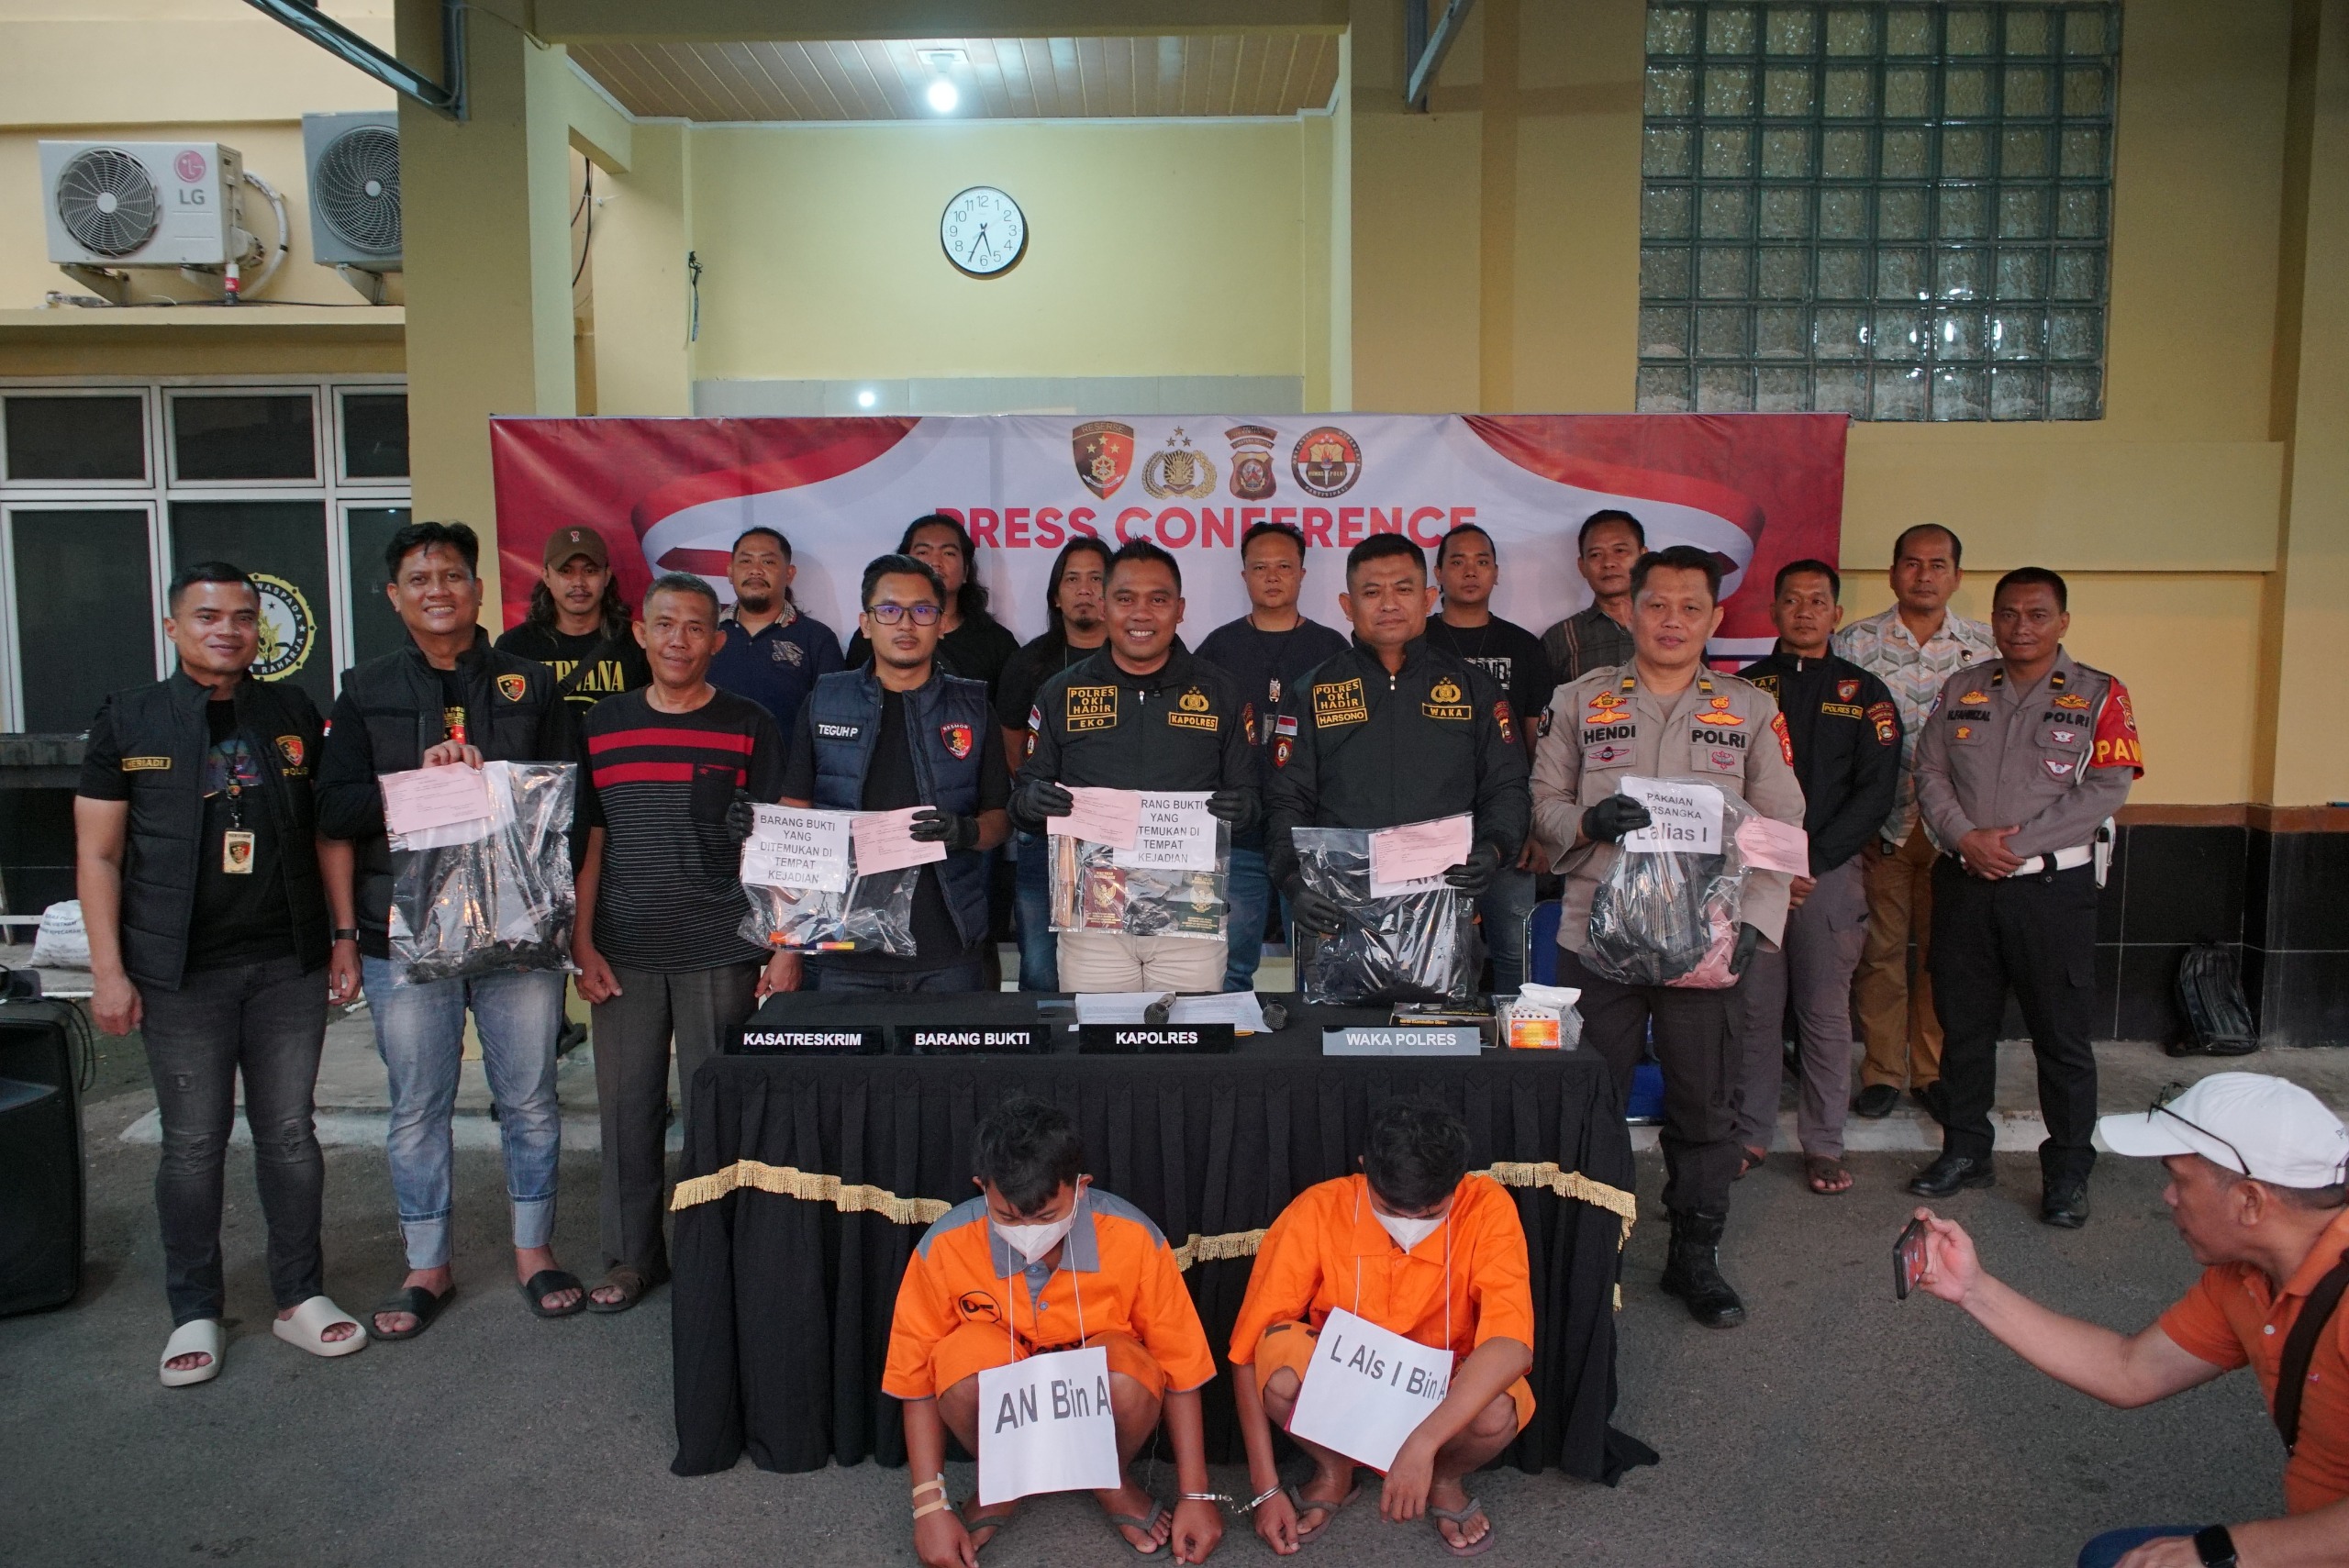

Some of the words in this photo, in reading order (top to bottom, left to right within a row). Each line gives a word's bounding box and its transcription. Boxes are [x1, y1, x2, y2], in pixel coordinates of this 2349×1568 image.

[179, 189, 205, 205] LG
[976, 195, 989, 207] 12
[964, 199, 974, 211] 11
[954, 210, 967, 222] 10
[1003, 210, 1012, 221] 2
[950, 226, 958, 237] 9
[1008, 225, 1017, 236] 3
[954, 240, 963, 251] 8
[1004, 239, 1013, 250] 4
[968, 251, 974, 262] 7
[980, 255, 988, 266] 6
[993, 250, 1001, 262] 5
[1082, 422, 1125, 434] RESERSE
[936, 506, 1097, 549] RESS
[261, 638, 305, 674] RAHARJA
[1071, 689, 1115, 698] POLRES
[1316, 682, 1360, 695] POLRES
[1082, 697, 1104, 706] OKI
[1328, 693, 1350, 701] OKI
[1074, 705, 1111, 714] HADIR
[1320, 698, 1359, 709] HADIR
[1430, 707, 1462, 717] WAKA
[1825, 706, 1850, 714] POLRES
[1080, 719, 1105, 728] EKO
[1171, 716, 1215, 728] KAPOLRES
[1319, 712, 1364, 725] HARSONO
[2043, 712, 2089, 728] POLRI
[818, 724, 850, 737] TEGUH
[850, 728, 858, 737] P
[1584, 725, 1636, 744] HENDI
[1692, 730, 1745, 749] POLRI
[1141, 799, 1170, 809] RANG
[1174, 800, 1203, 809] BUKTI
[1646, 793, 1693, 806] PAKAIAN
[1151, 813, 1179, 823] YANG
[1643, 806, 1702, 819] RSANGKA
[760, 815, 803, 828] BARANG
[807, 819, 836, 831] BUKTI
[784, 829, 812, 841] YANG
[1138, 826, 1186, 836] TEMUKAN
[1190, 828, 1199, 836] DI
[1650, 822, 1695, 841] alias
[760, 841, 820, 856] DITEMUKAN
[822, 848, 832, 857] DI
[1143, 840, 1184, 850] TEMPAT
[775, 857, 816, 869] TEMPAT
[1138, 852, 1187, 863] KEJADIAN
[768, 870, 819, 884] KEJADIAN
[743, 1033, 862, 1046] KASATRESKRIM
[916, 1033, 981, 1046] BARANG
[985, 1032, 1030, 1045] BUKTI
[1116, 1031, 1198, 1045] KAPOLRES
[1346, 1033, 1393, 1046] WAKA
[1396, 1033, 1457, 1046] POLRES
[1330, 1334, 1342, 1363] L
[1348, 1344, 1386, 1380] Als
[1406, 1367, 1438, 1401] Bin
[995, 1384, 1039, 1434] AN
[1051, 1378, 1090, 1420] Bin
[1097, 1375, 1112, 1416] A
